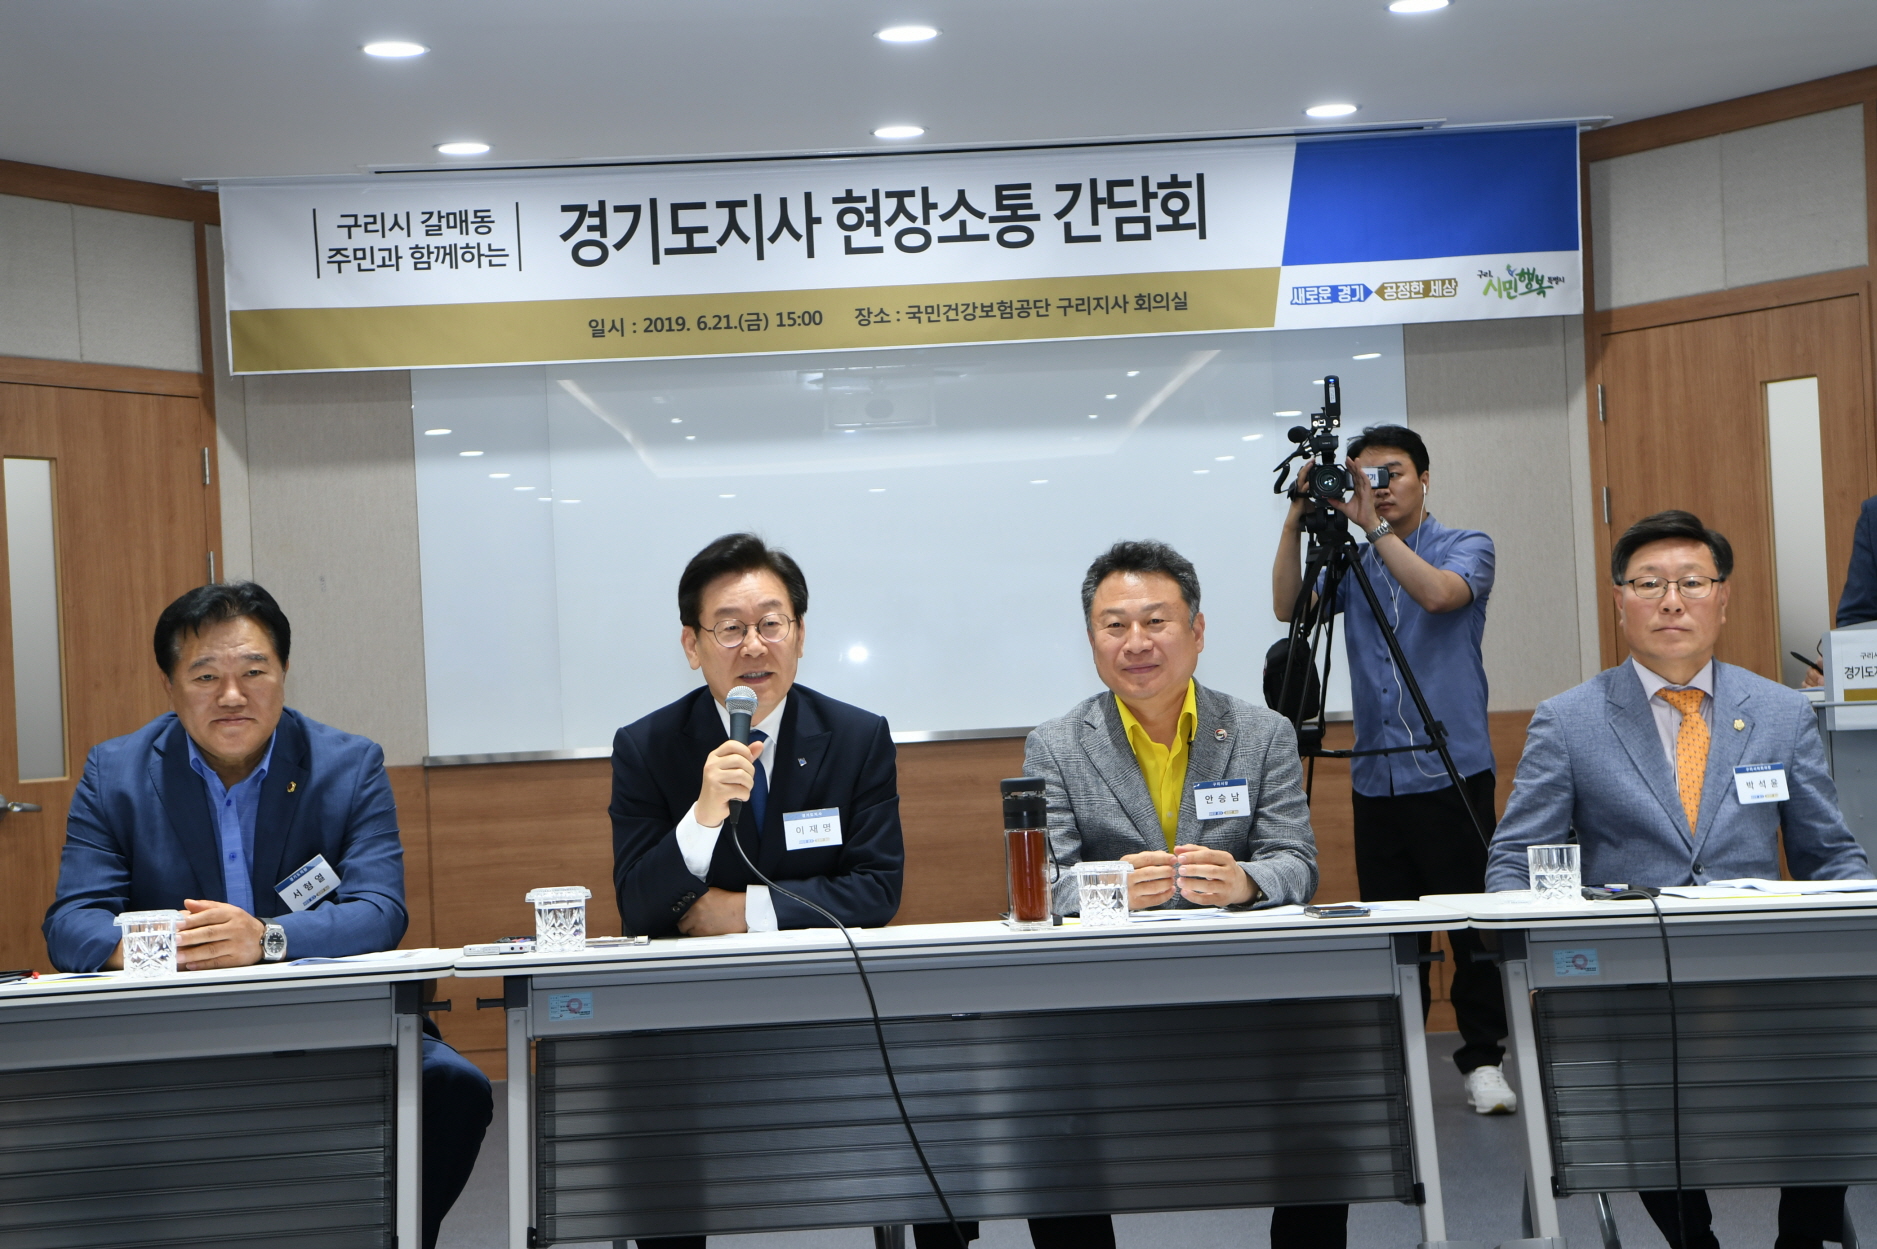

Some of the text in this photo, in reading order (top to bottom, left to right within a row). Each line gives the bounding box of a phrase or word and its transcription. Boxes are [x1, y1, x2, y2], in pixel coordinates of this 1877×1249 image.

[336, 208, 495, 240] 구리시 갈매동
[559, 173, 1207, 267] 경기도지사 현장소통 간담회
[326, 242, 510, 273] 주민과 함께하는
[1292, 279, 1457, 304] 새로운 경기 공정한 세상
[588, 317, 625, 338] 일시
[643, 316, 691, 333] 2019.
[696, 312, 769, 332] 6.21.(금)
[776, 310, 823, 328] 15:00
[854, 306, 891, 327] 장소
[905, 298, 1051, 325] 국민건강보험공단
[1056, 295, 1129, 318] 구리지사
[1133, 291, 1189, 314] 회의실
